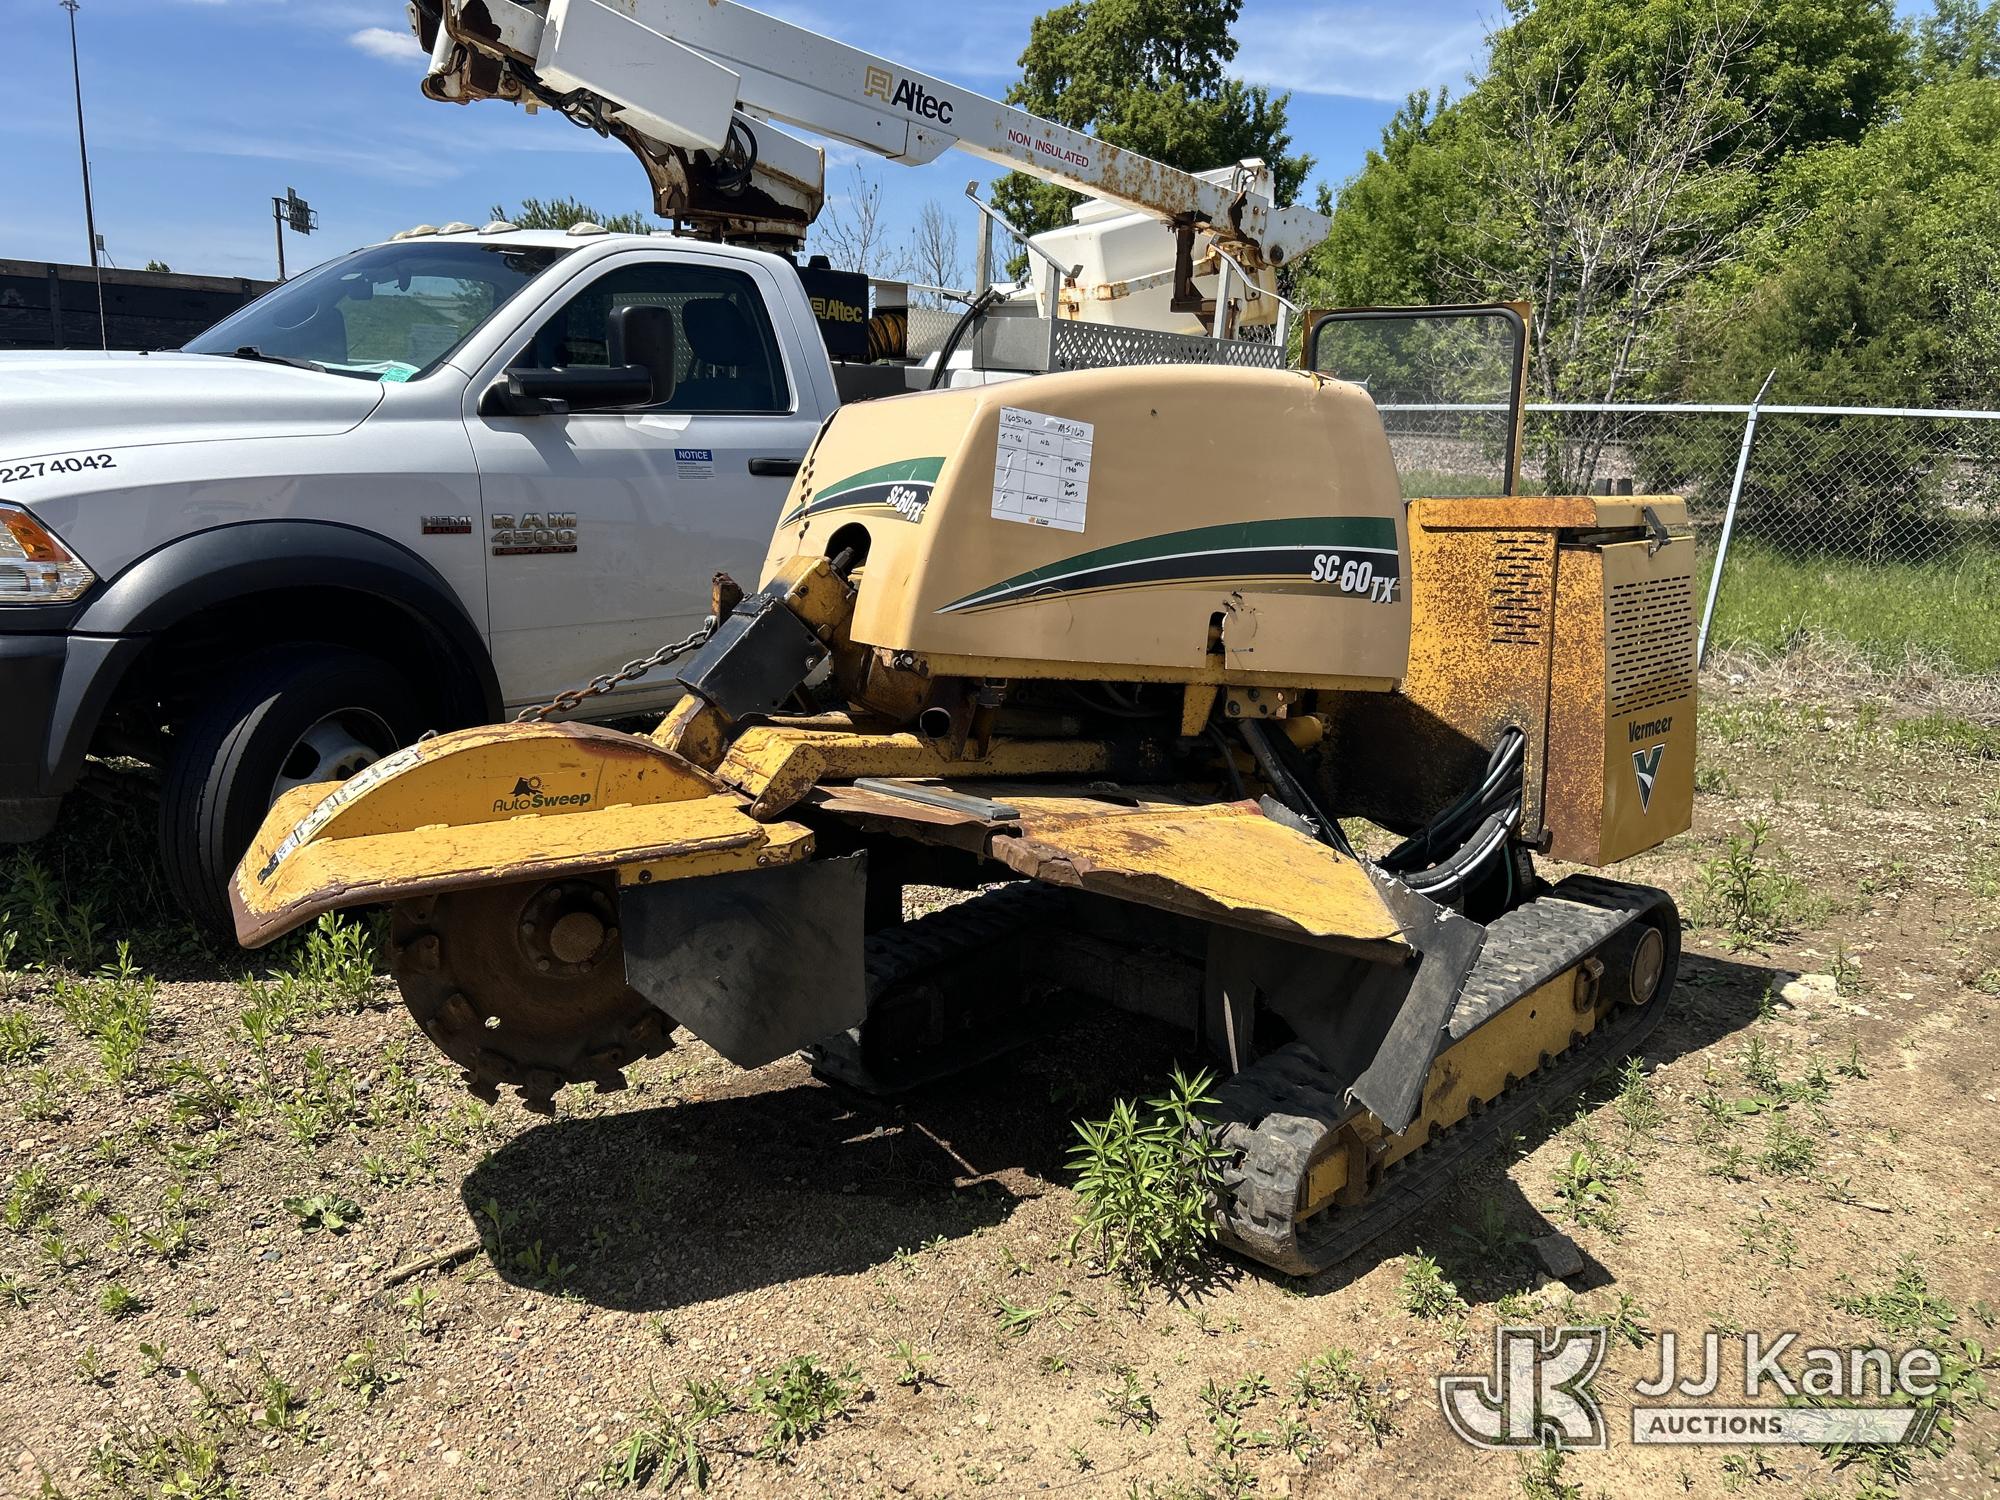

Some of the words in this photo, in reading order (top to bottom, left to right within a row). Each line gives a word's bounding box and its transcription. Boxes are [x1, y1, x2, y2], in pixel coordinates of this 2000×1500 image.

[891, 78, 954, 124] Altec
[1007, 128, 1032, 147] NON
[1034, 138, 1090, 169] INSULATED
[826, 299, 863, 323] Altec
[678, 450, 709, 460] NOTICE
[0, 454, 117, 483] 2274042
[420, 515, 472, 527] HEMI
[491, 512, 578, 529] RAM
[490, 529, 578, 545] 4500
[1628, 716, 1673, 742] Vermeer
[492, 792, 592, 813] AutoSweep
